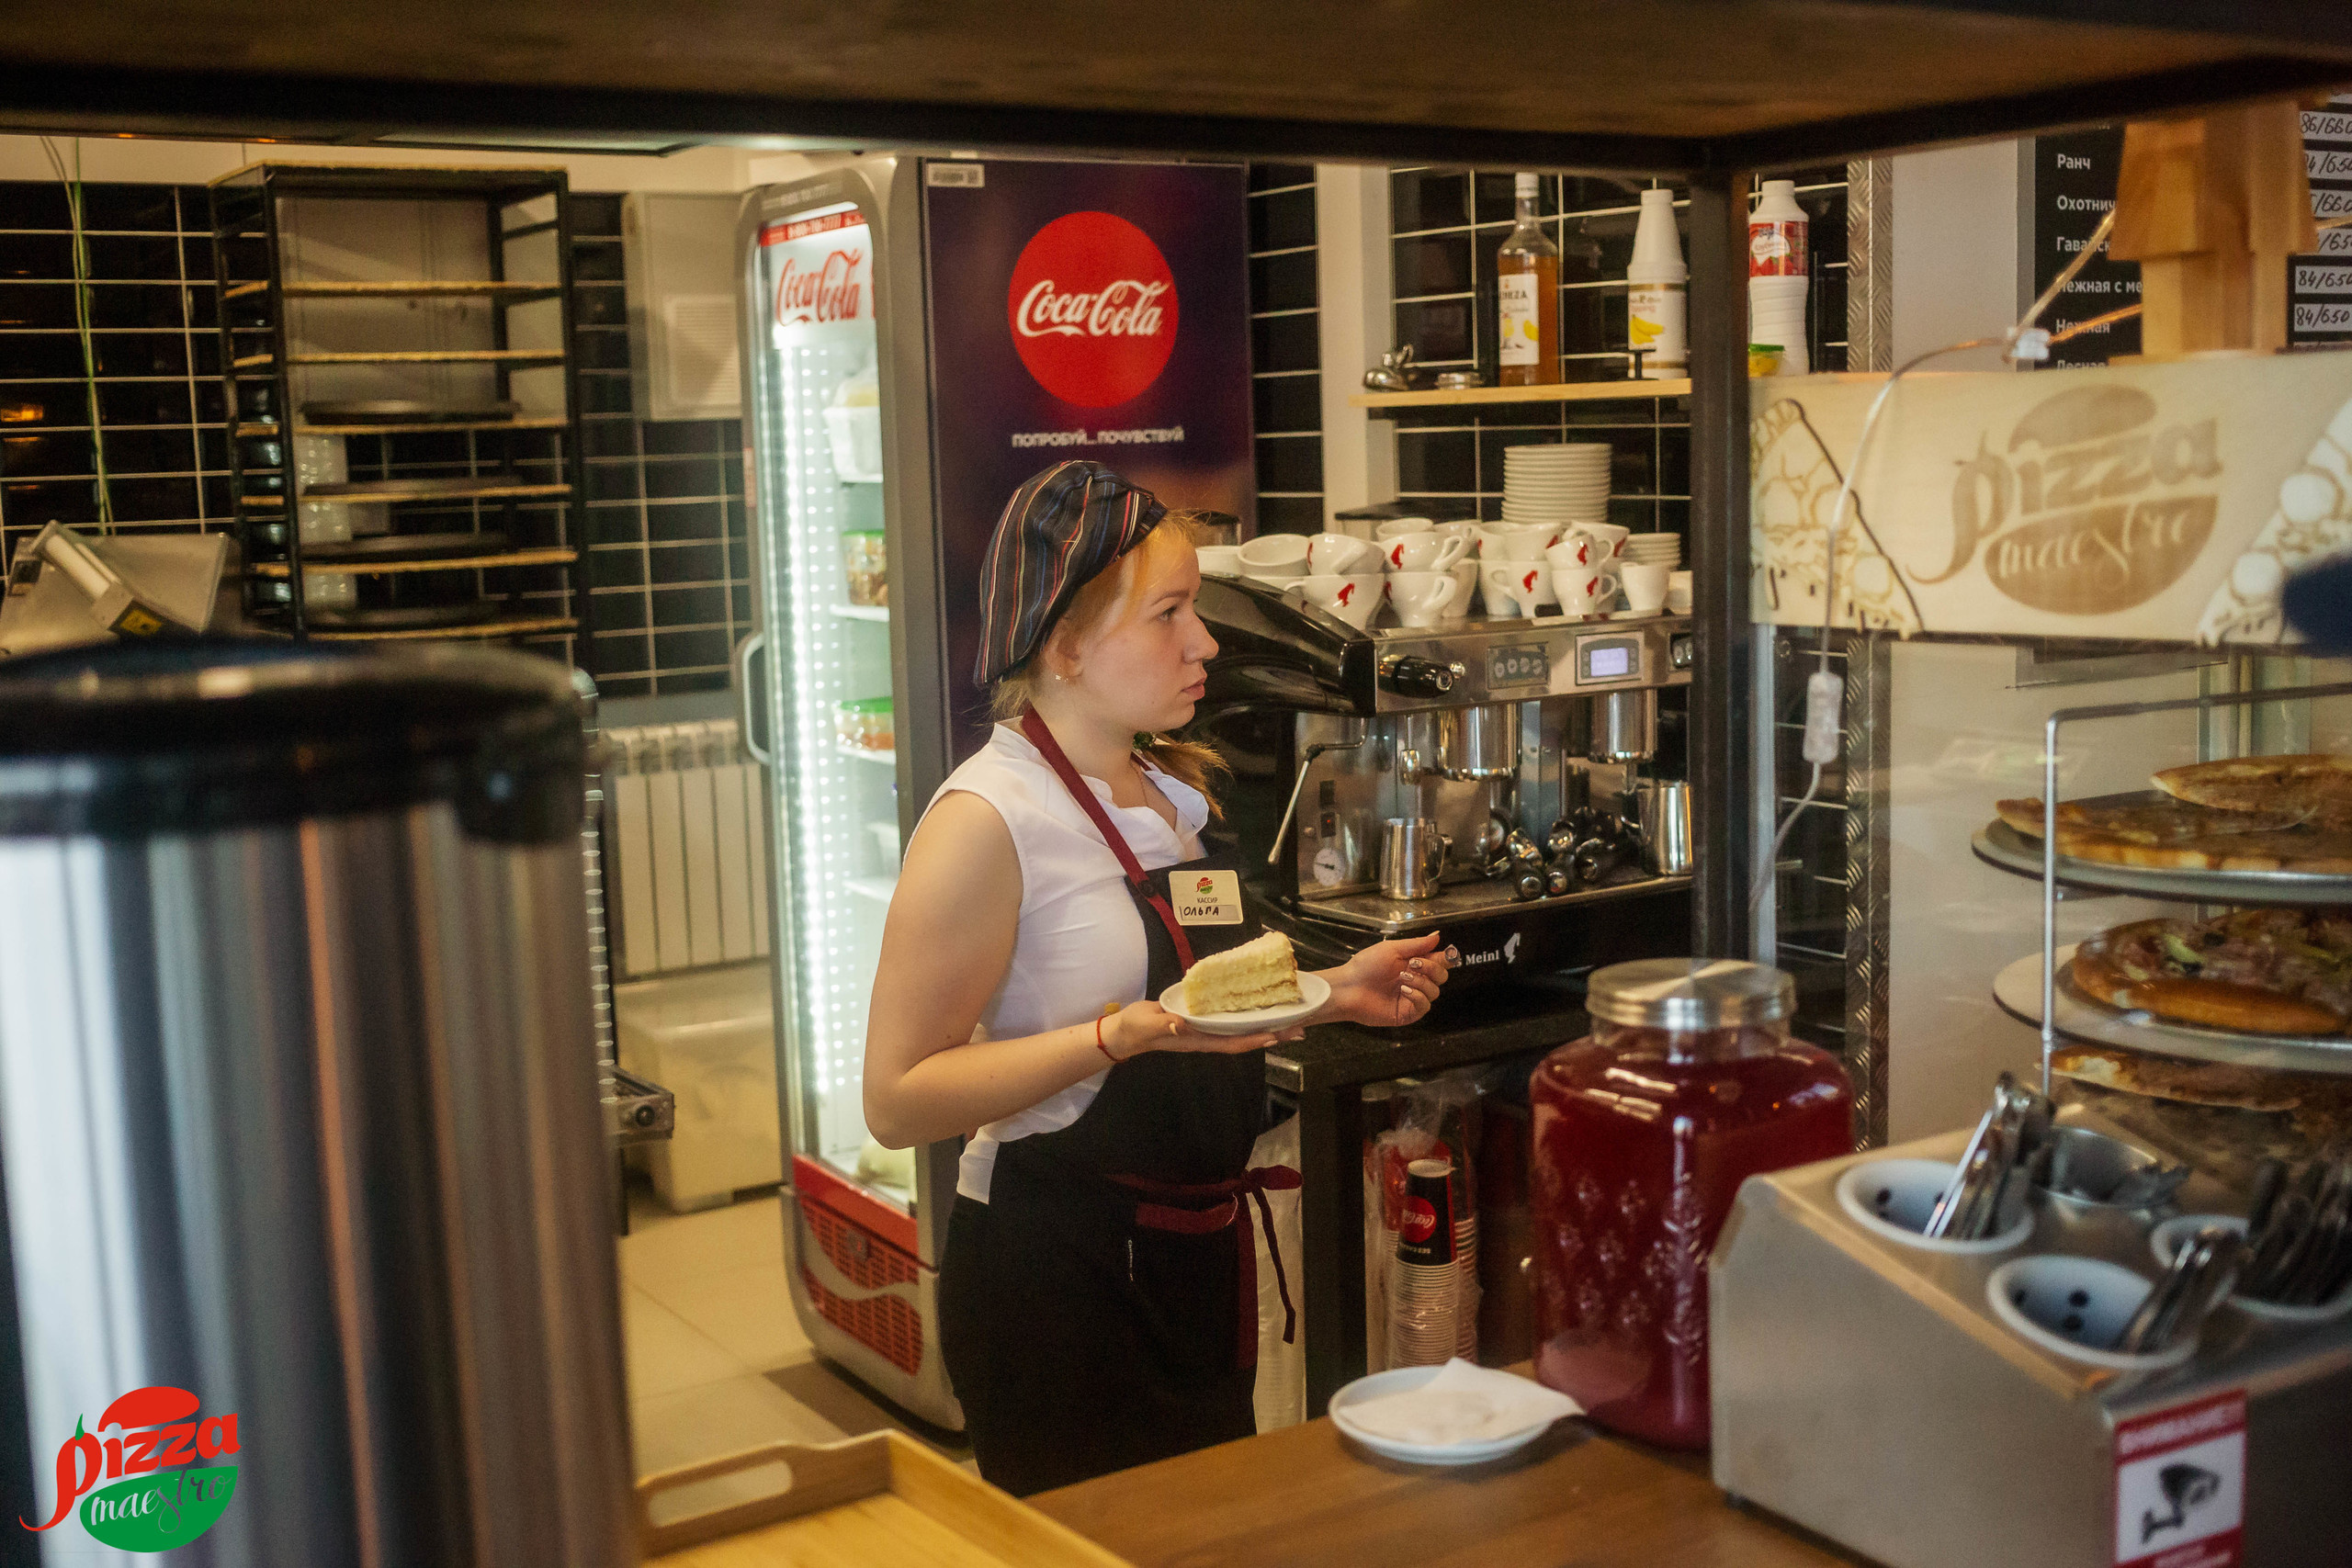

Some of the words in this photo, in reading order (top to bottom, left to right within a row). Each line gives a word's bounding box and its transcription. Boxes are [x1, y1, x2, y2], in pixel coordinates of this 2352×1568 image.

[2057, 153, 2091, 170] Ранч
[776, 248, 865, 327] Coca-Cola
[1016, 278, 1172, 338] Coca-Cola
[2296, 303, 2350, 328] 84/650
[1905, 418, 2223, 585] pizza
[1183, 906, 1220, 917] ОЛЬГА
[1465, 949, 1500, 966] Meinl
